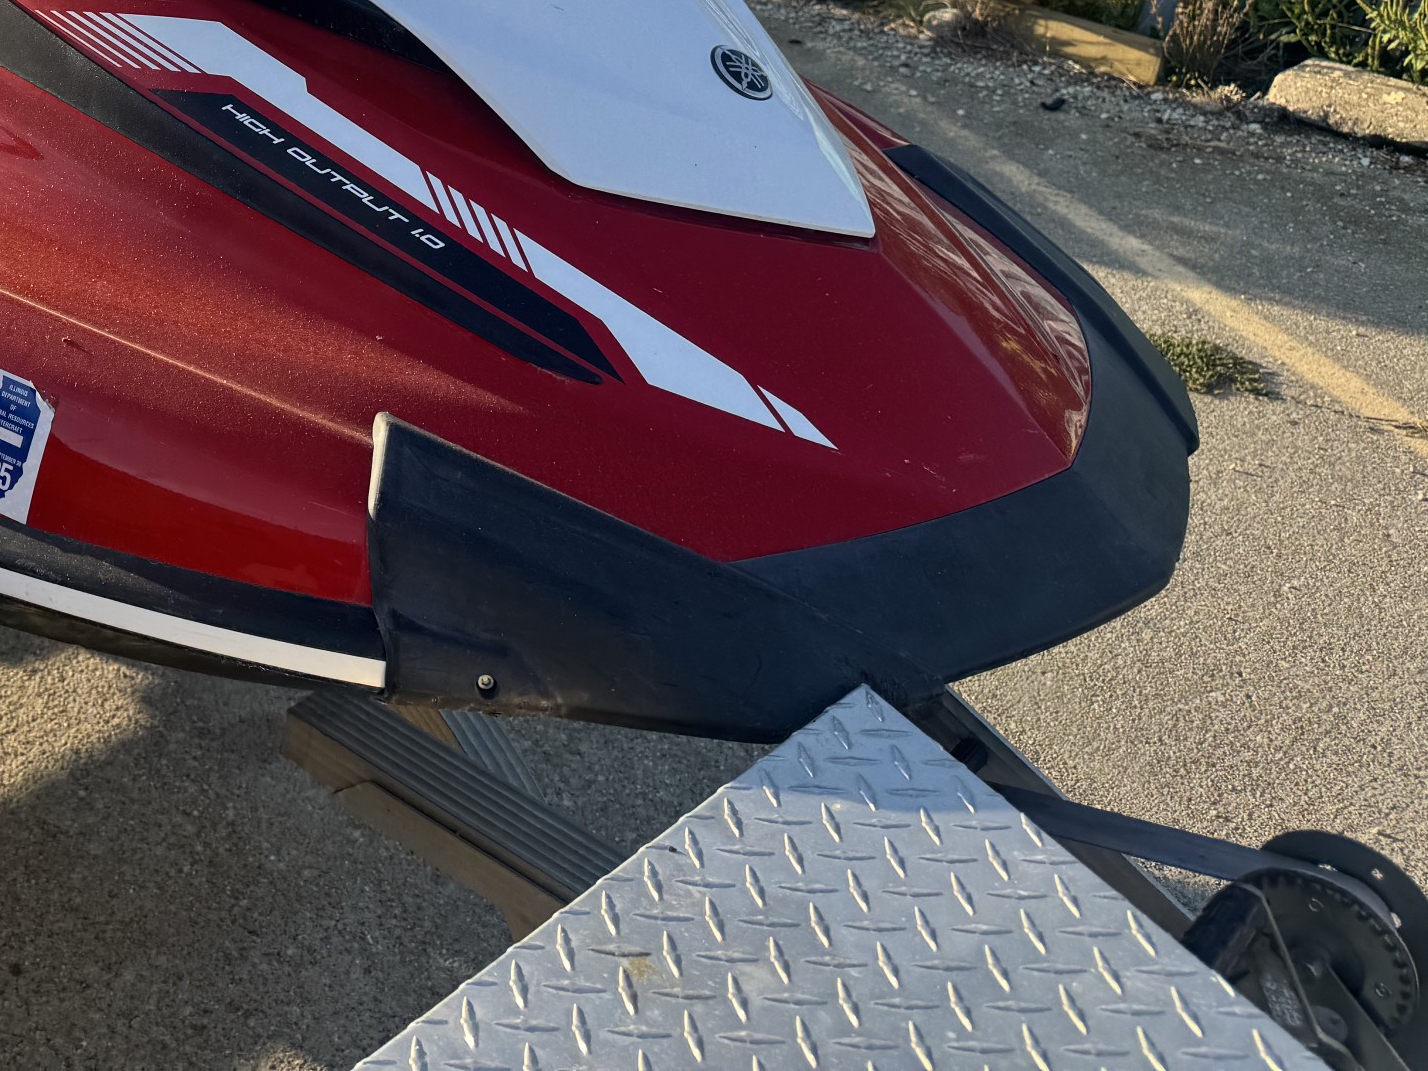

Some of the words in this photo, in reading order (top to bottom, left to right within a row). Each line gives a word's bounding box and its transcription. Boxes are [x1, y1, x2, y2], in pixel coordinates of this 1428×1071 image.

[221, 104, 285, 145] HIGH
[286, 146, 410, 223] OUTPUT
[410, 228, 446, 250] 1.0
[9, 384, 29, 397] ILLINOIS
[1, 391, 31, 408] DEPARTMENT
[10, 404, 18, 412] OF
[8, 413, 35, 429] RESOURCES
